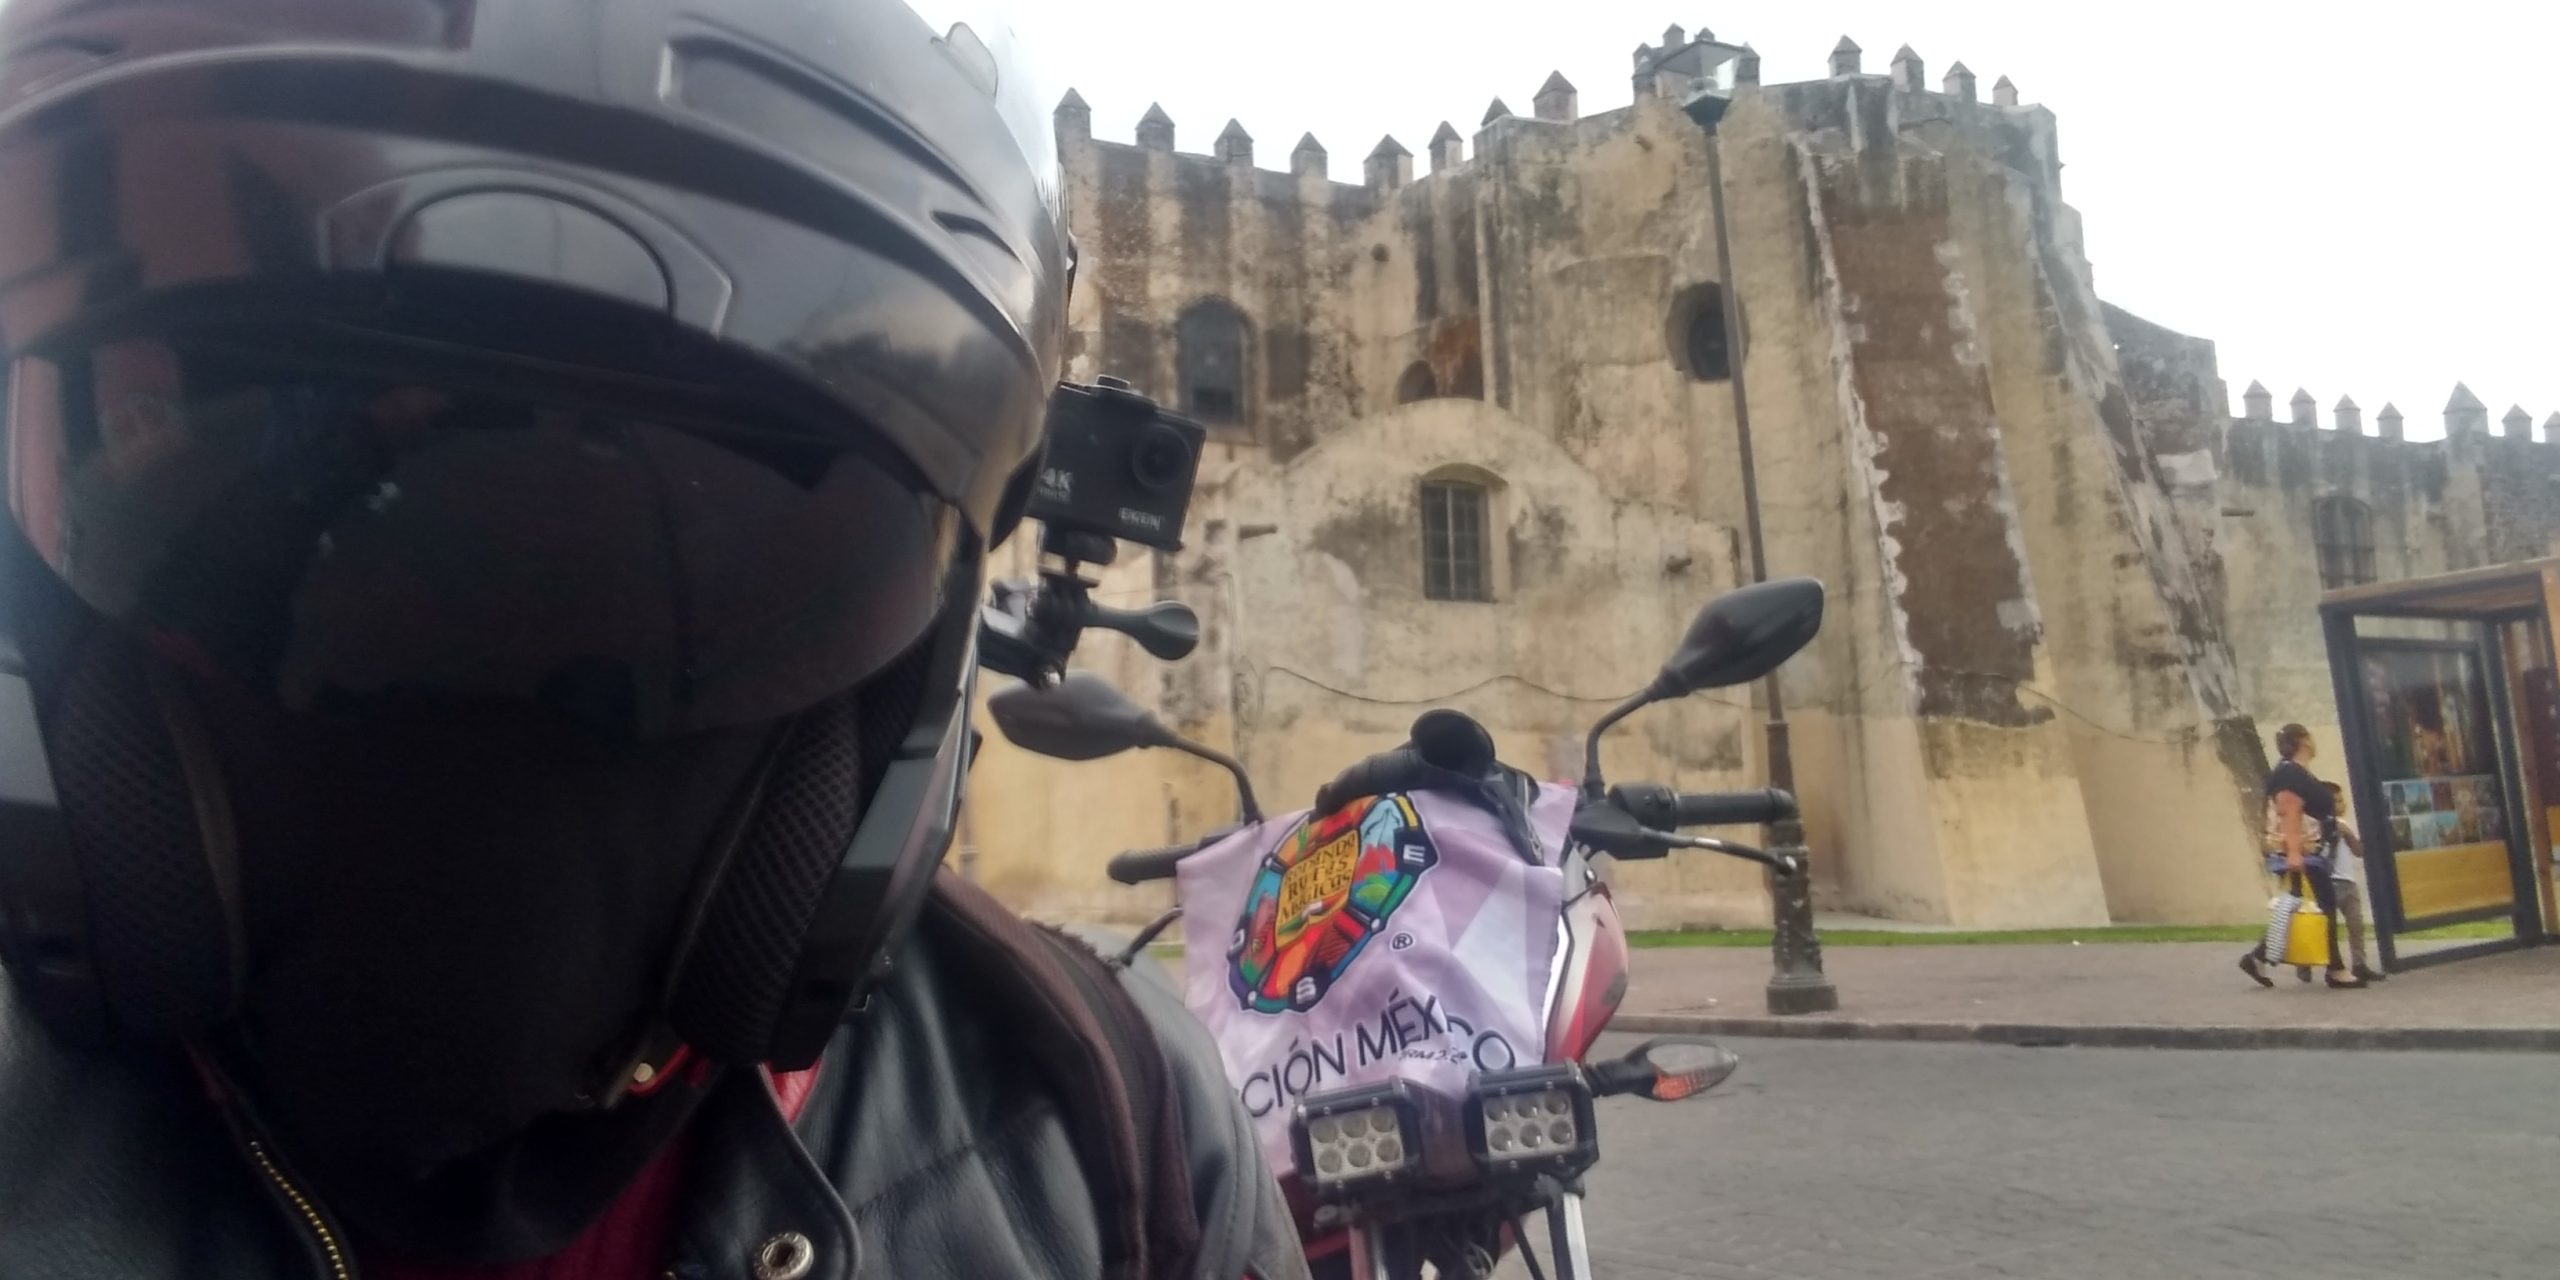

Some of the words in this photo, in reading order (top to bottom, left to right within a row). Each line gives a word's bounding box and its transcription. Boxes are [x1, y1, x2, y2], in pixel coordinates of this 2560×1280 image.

[1040, 468, 1073, 492] 4K
[1403, 844, 1425, 864] E
[1296, 976, 1316, 1004] S
[1356, 987, 1515, 1072] MÉXO
